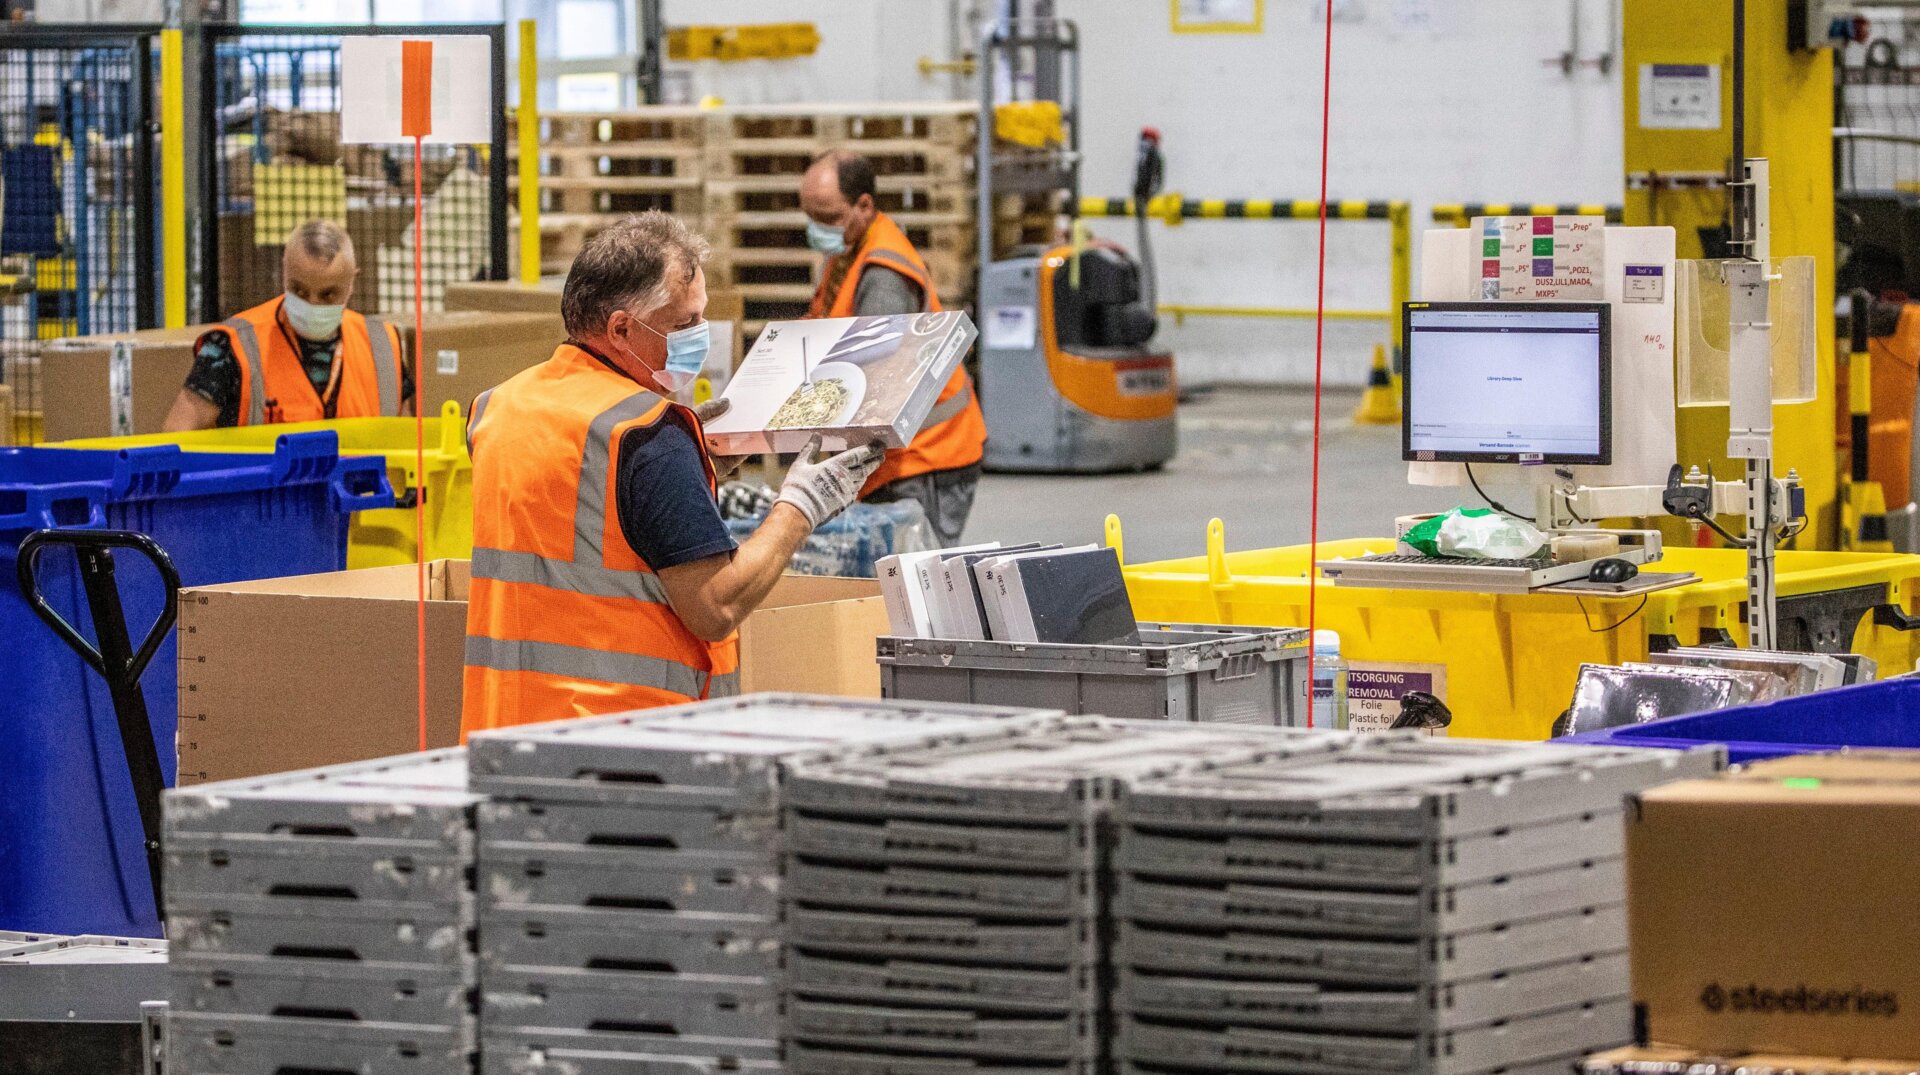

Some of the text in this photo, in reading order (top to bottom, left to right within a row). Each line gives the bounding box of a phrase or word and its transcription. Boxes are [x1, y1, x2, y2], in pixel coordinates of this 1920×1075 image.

[198, 596, 209, 605] 100
[1348, 687, 1395, 699] REMOVAL
[1361, 700, 1382, 710] Folie
[1349, 712, 1395, 724] Plastic foil
[189, 742, 198, 750] 75
[198, 771, 207, 780] 70
